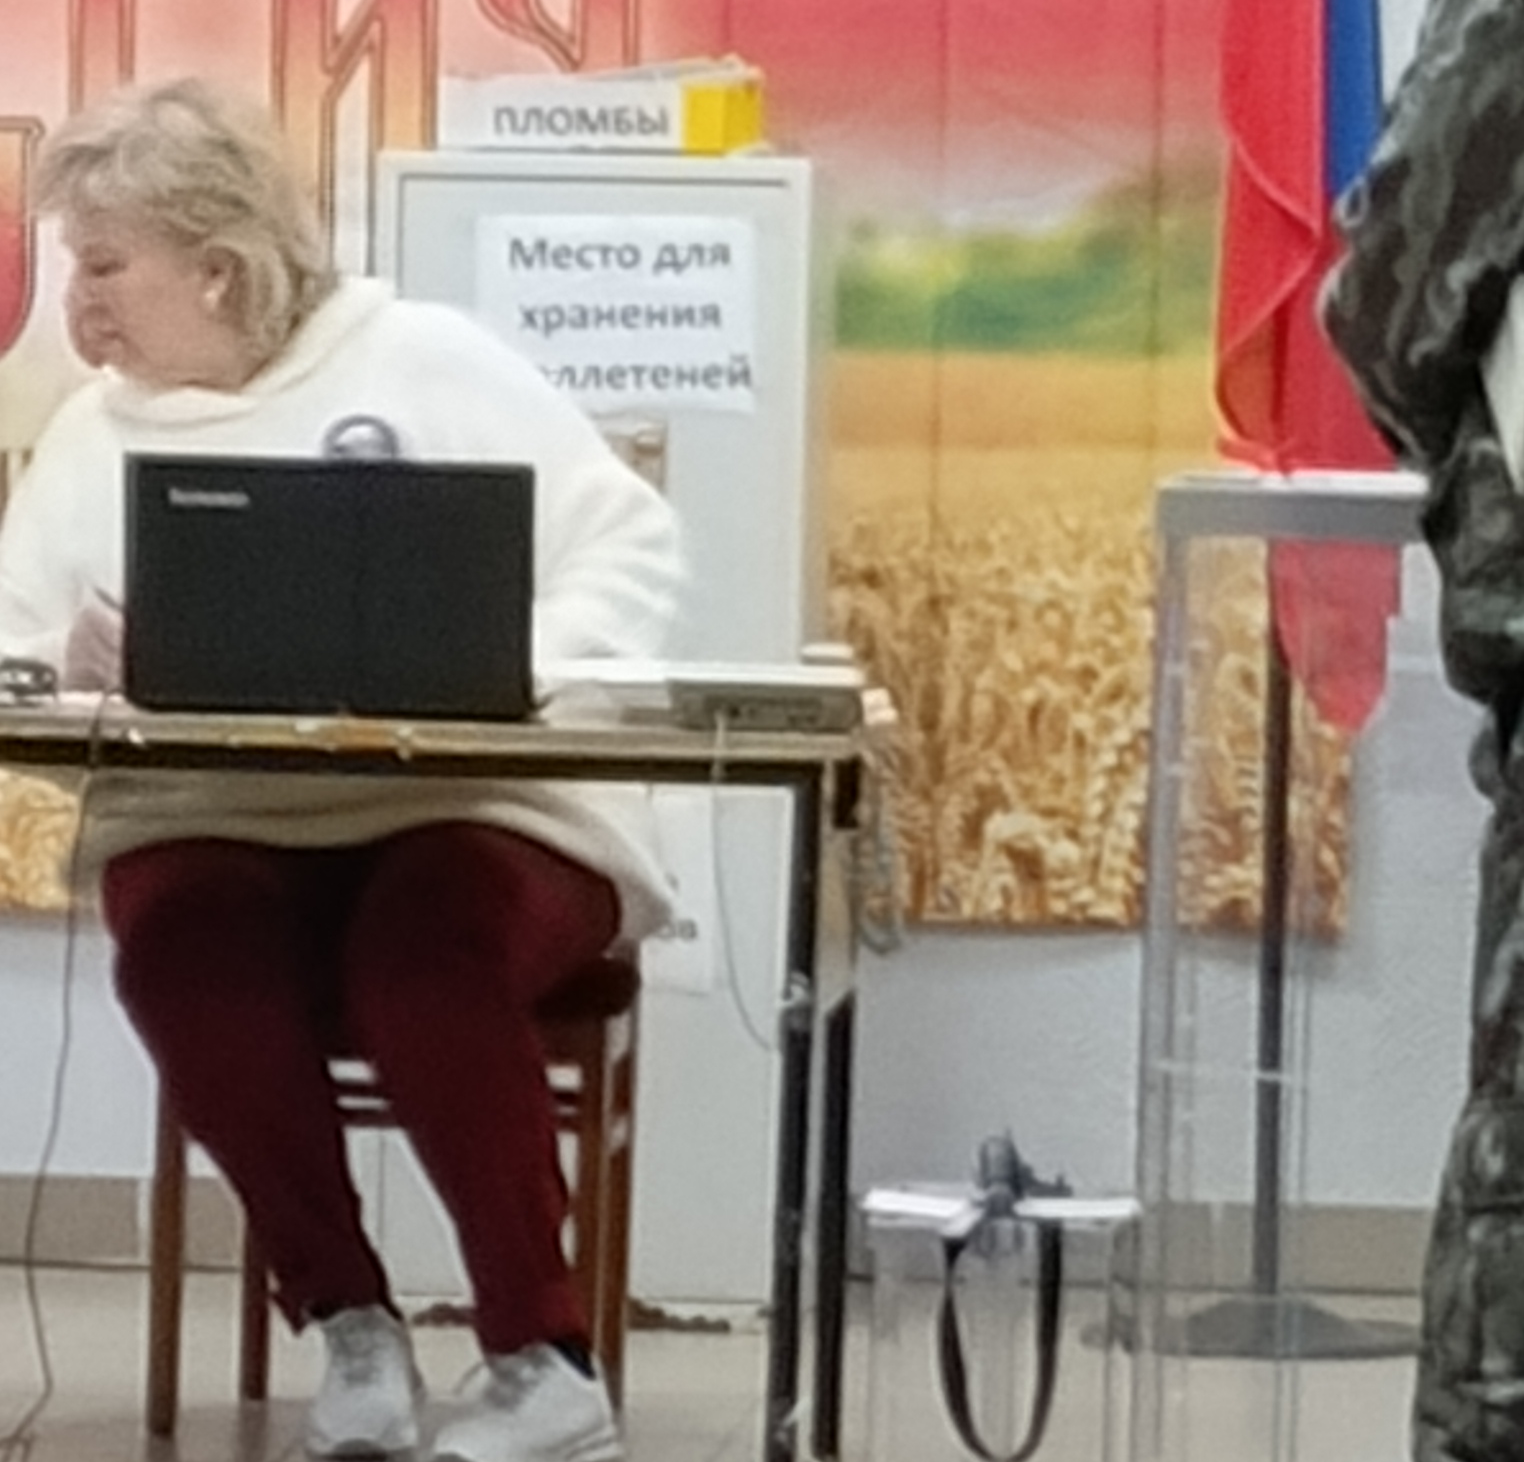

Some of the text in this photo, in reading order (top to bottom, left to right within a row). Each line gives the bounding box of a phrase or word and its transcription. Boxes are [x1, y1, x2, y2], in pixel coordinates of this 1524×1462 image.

[493, 106, 669, 136] ПЛОМБЫ
[509, 238, 731, 274] Место для
[519, 304, 721, 338] хранения
